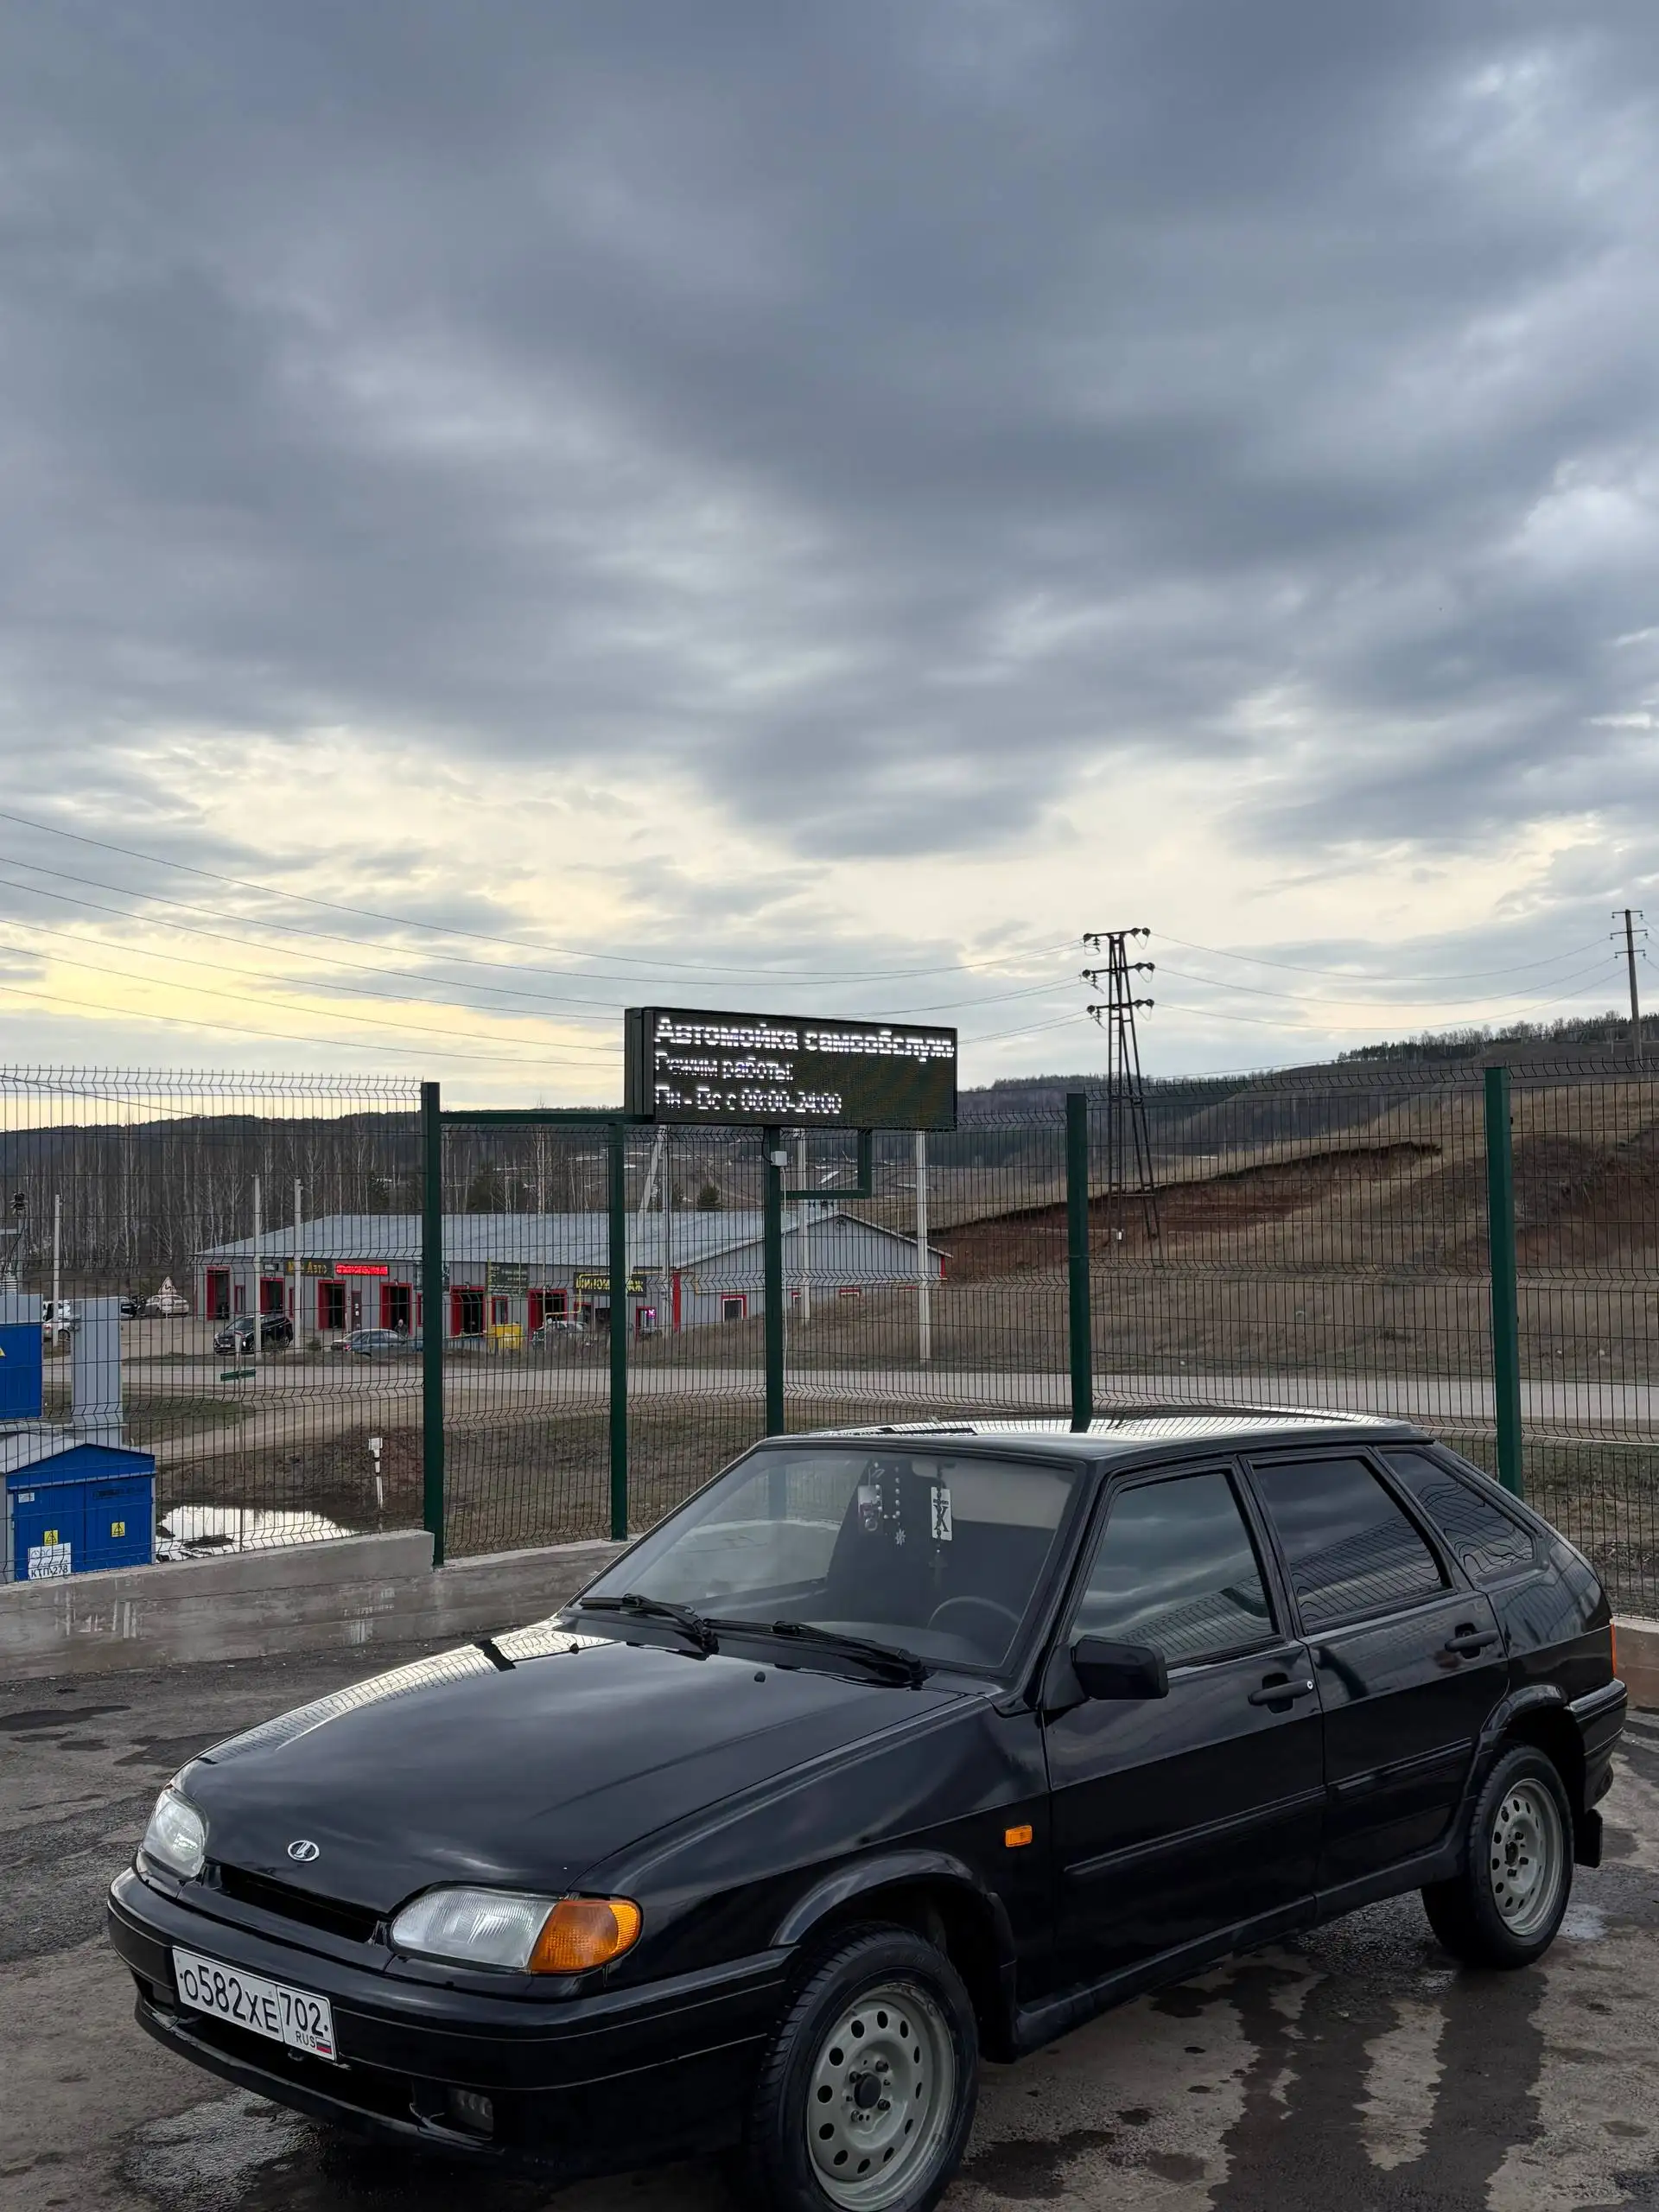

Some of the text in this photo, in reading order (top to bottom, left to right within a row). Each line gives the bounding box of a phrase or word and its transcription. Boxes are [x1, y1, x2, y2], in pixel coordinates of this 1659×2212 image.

[654, 1017, 799, 1051] Автомойка
[654, 1051, 718, 1077] Режим
[279, 1991, 324, 2037] 702
[295, 2030, 316, 2049] RUS
